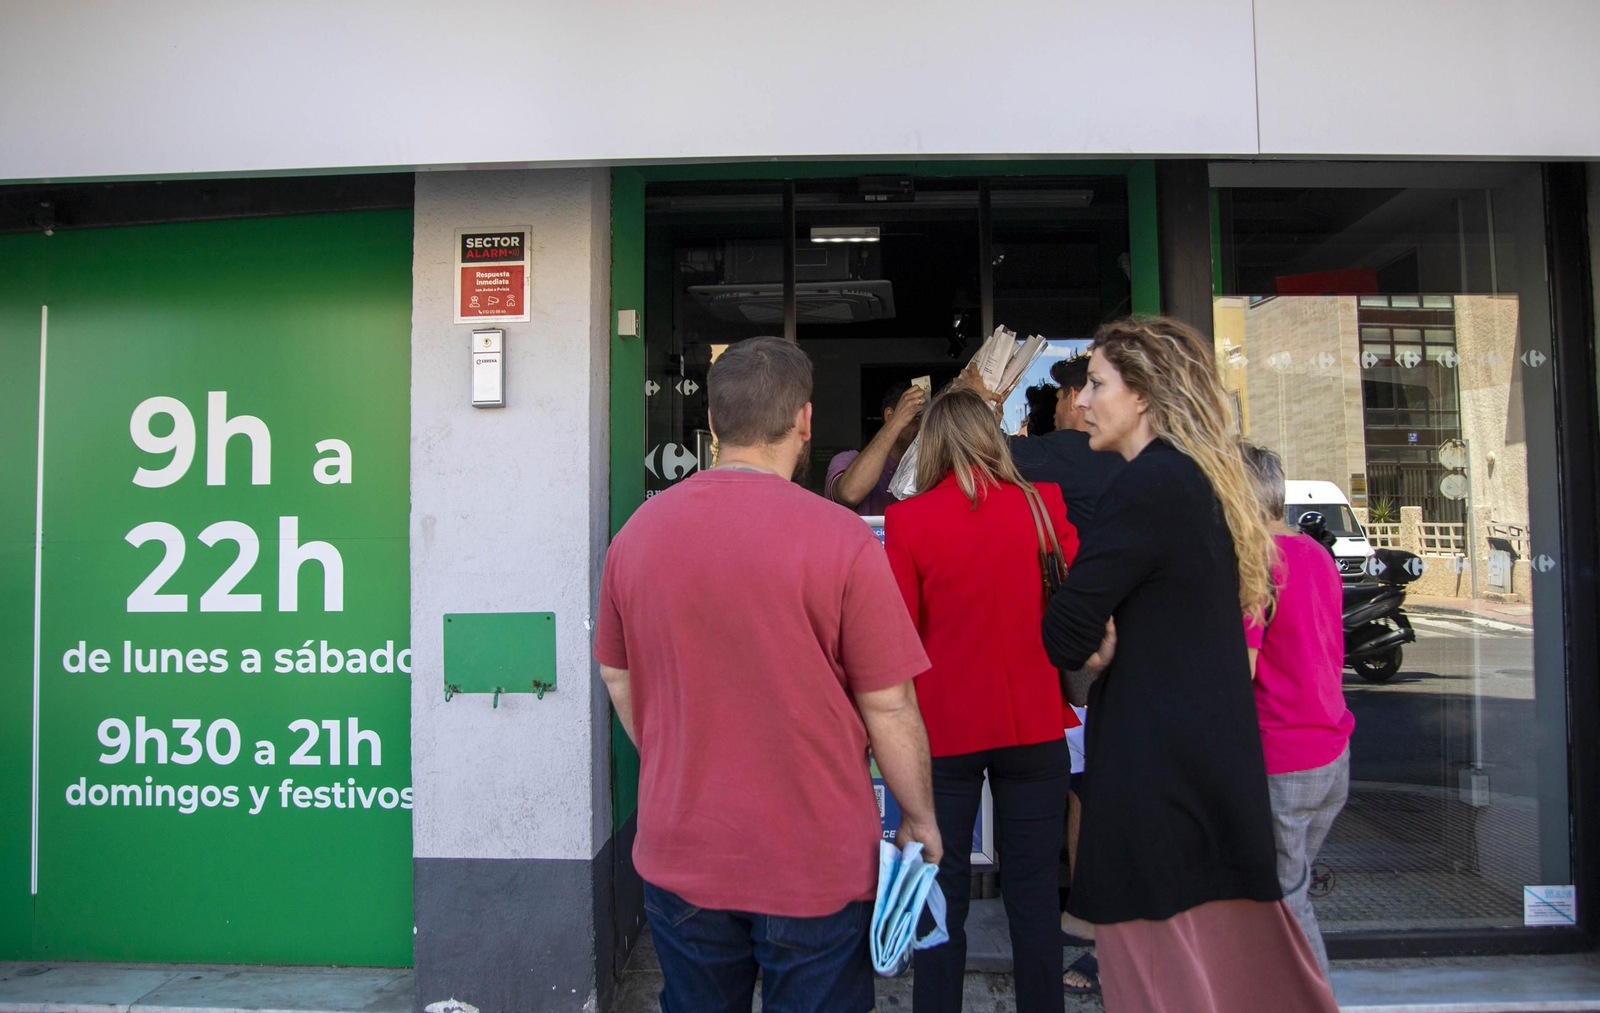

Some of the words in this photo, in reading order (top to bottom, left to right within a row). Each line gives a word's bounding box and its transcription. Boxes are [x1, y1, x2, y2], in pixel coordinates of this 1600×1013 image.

[466, 237, 519, 248] SECTOR
[467, 249, 507, 258] ALARM
[130, 391, 271, 489] 9h
[313, 438, 352, 485] a
[125, 516, 343, 612] 22h
[63, 640, 110, 673] de
[124, 640, 228, 674] lunes
[241, 648, 261, 674] a
[97, 716, 241, 765] 9h30
[254, 740, 275, 765] a
[287, 717, 382, 766] 21h
[65, 775, 239, 815] domingos
[249, 785, 269, 815] y
[279, 778, 412, 810] festivos
